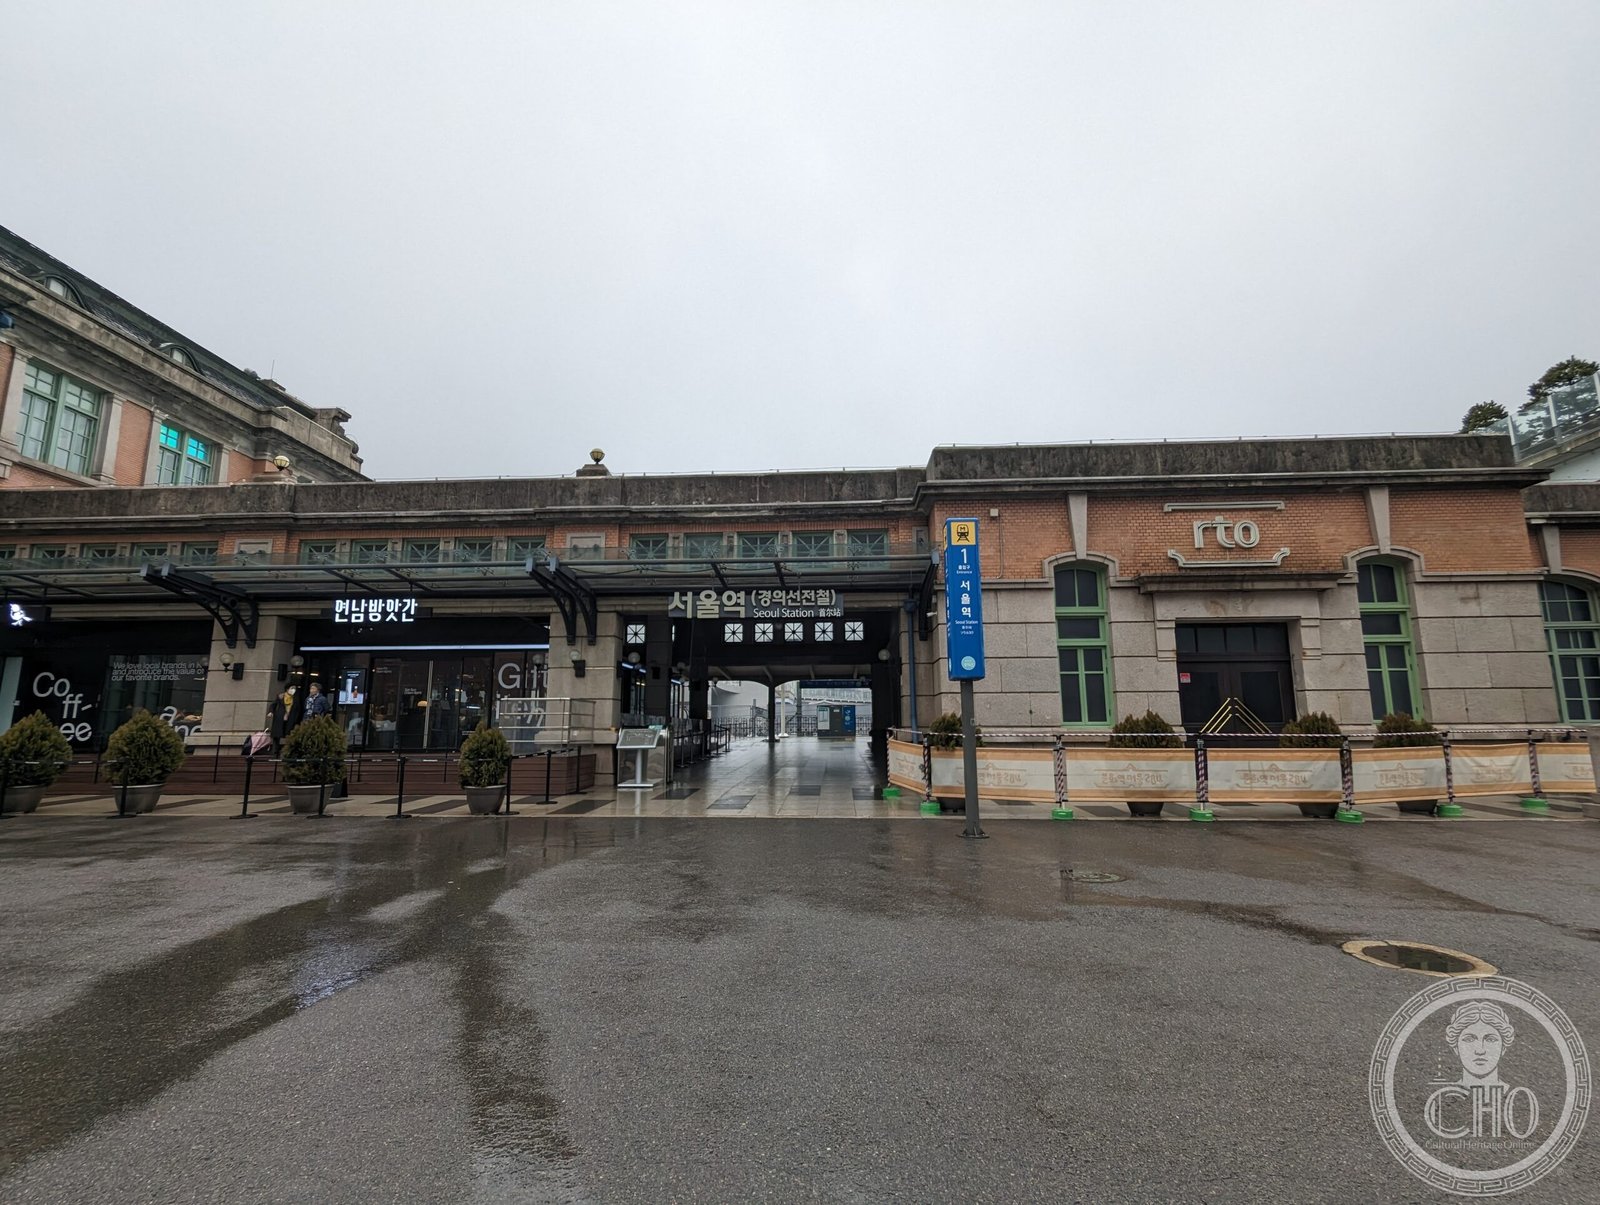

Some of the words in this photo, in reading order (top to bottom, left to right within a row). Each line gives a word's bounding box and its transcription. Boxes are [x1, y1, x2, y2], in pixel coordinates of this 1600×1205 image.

[1193, 515, 1260, 549] rto
[960, 548, 967, 564] 1
[668, 589, 746, 619] 서울역
[750, 589, 836, 607] (경의선전철)
[335, 598, 419, 623] 연남방앗간
[753, 607, 780, 618] Seoul
[781, 607, 814, 618] Station
[818, 607, 842, 617] 首尔站
